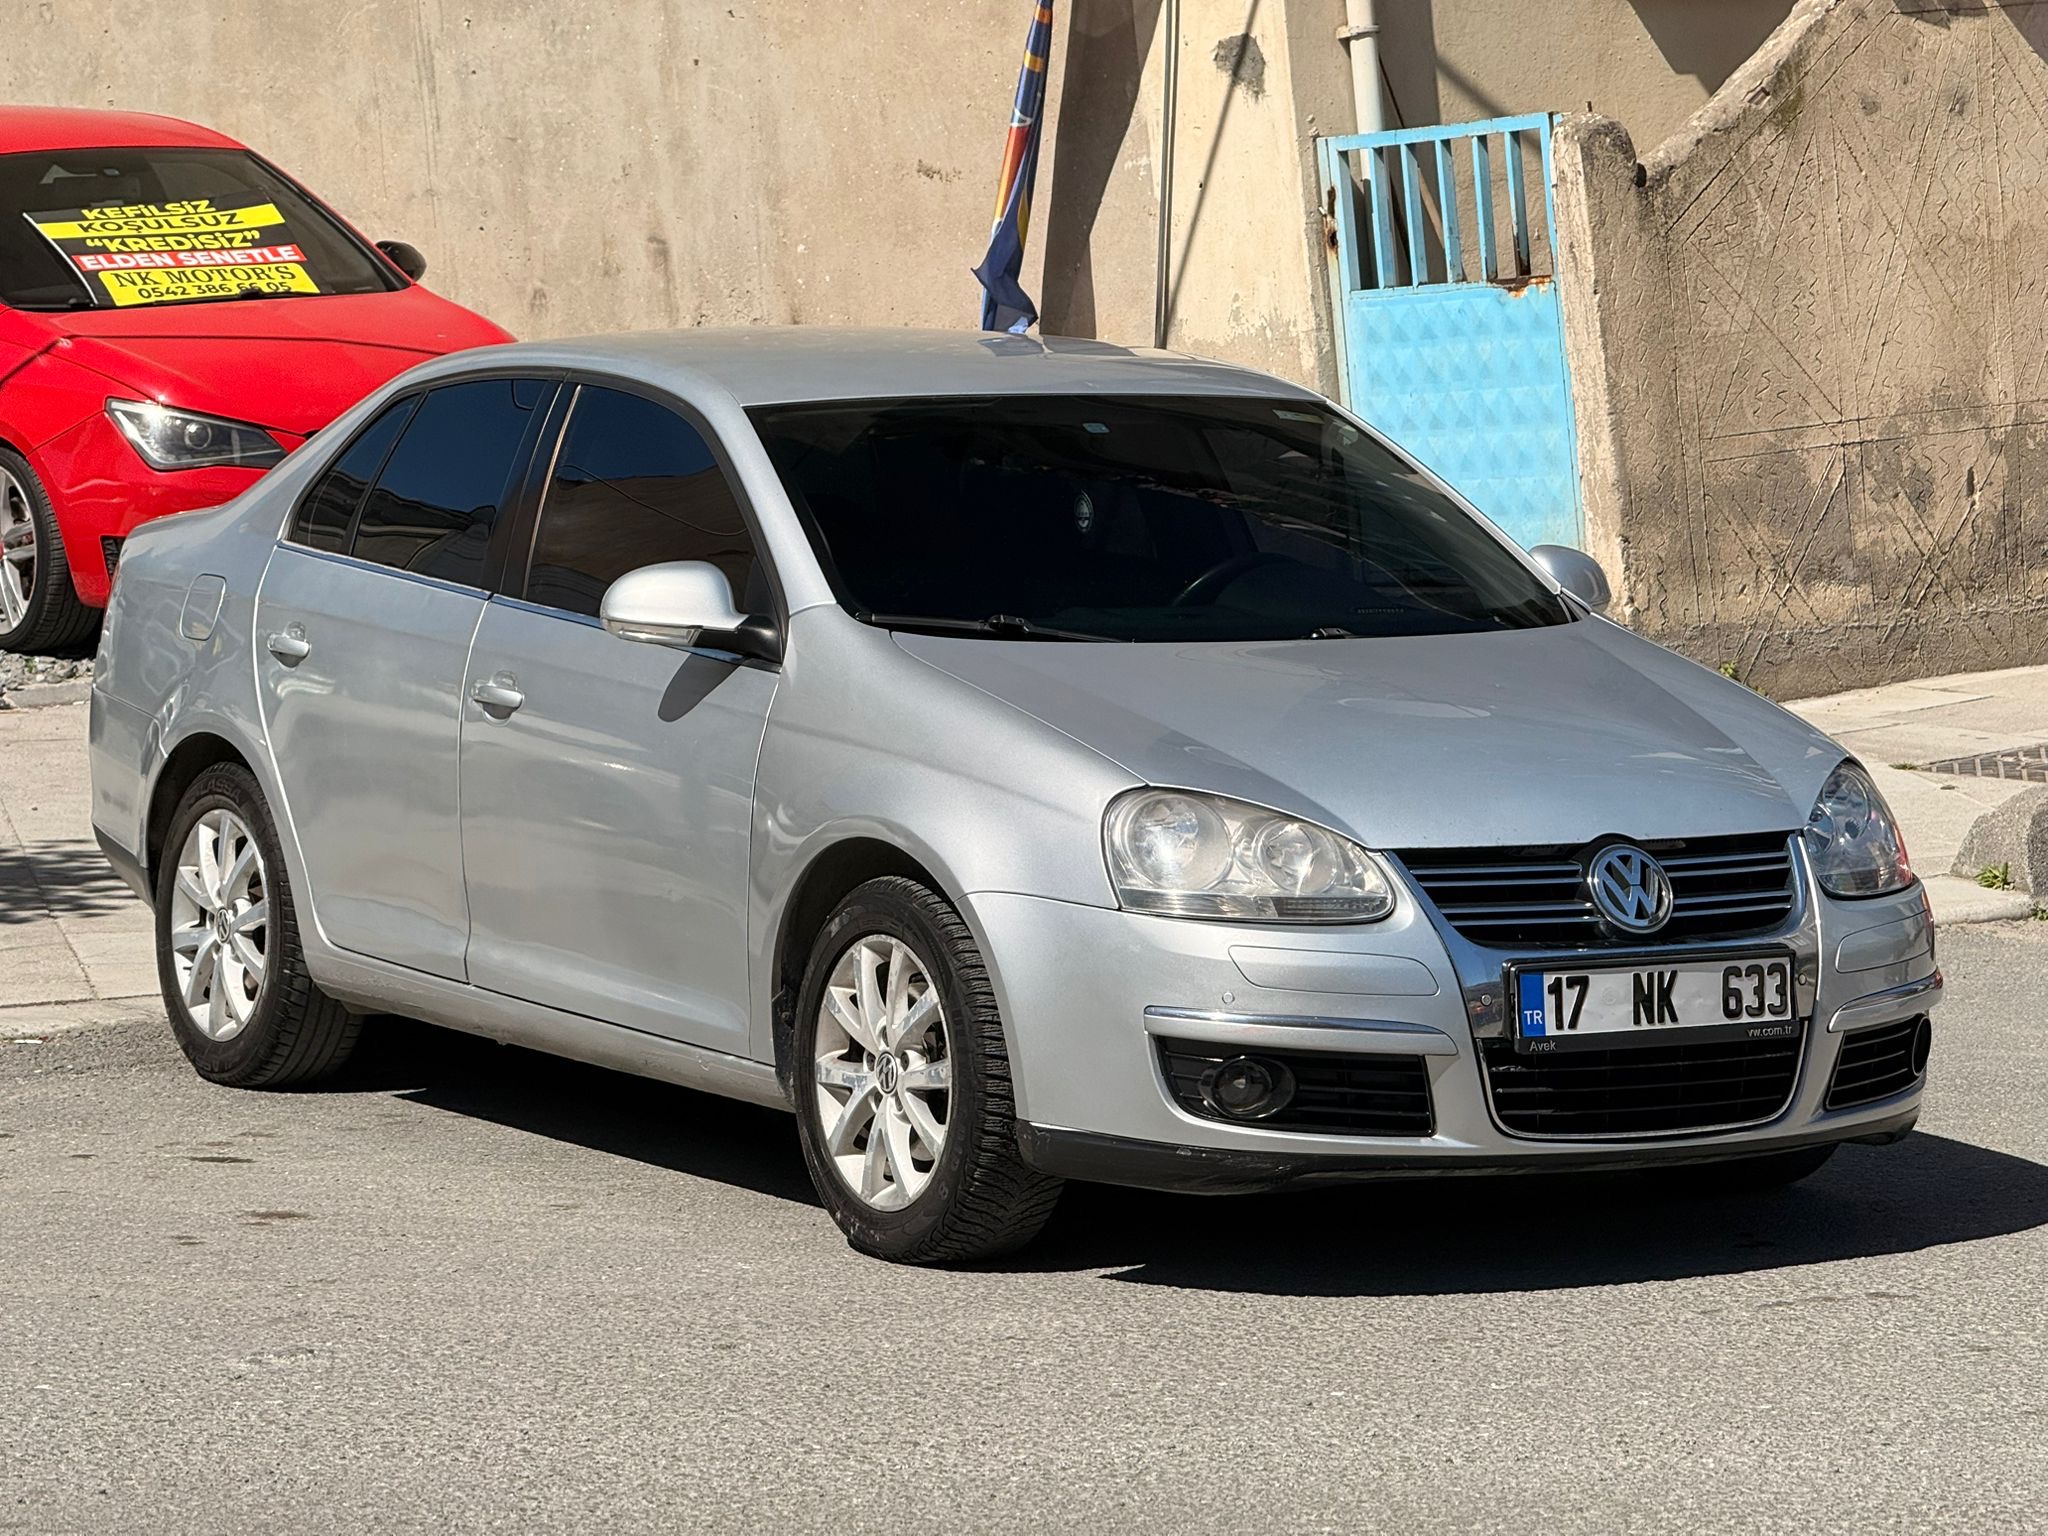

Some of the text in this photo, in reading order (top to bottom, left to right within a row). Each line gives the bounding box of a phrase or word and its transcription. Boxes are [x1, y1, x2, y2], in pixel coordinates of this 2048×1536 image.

[78, 212, 244, 233] KOŞULSUZ
[80, 245, 299, 270] ELDEN SENETLE
[112, 271, 161, 287] NK
[137, 287, 191, 299] 0542
[191, 283, 233, 295] 386
[266, 281, 292, 292] 05
[1547, 962, 1788, 1030] 17 NK 633
[1524, 1009, 1543, 1026] TR
[1746, 1025, 1793, 1038] vw.com.tr
[1529, 1040, 1557, 1052] Avek
